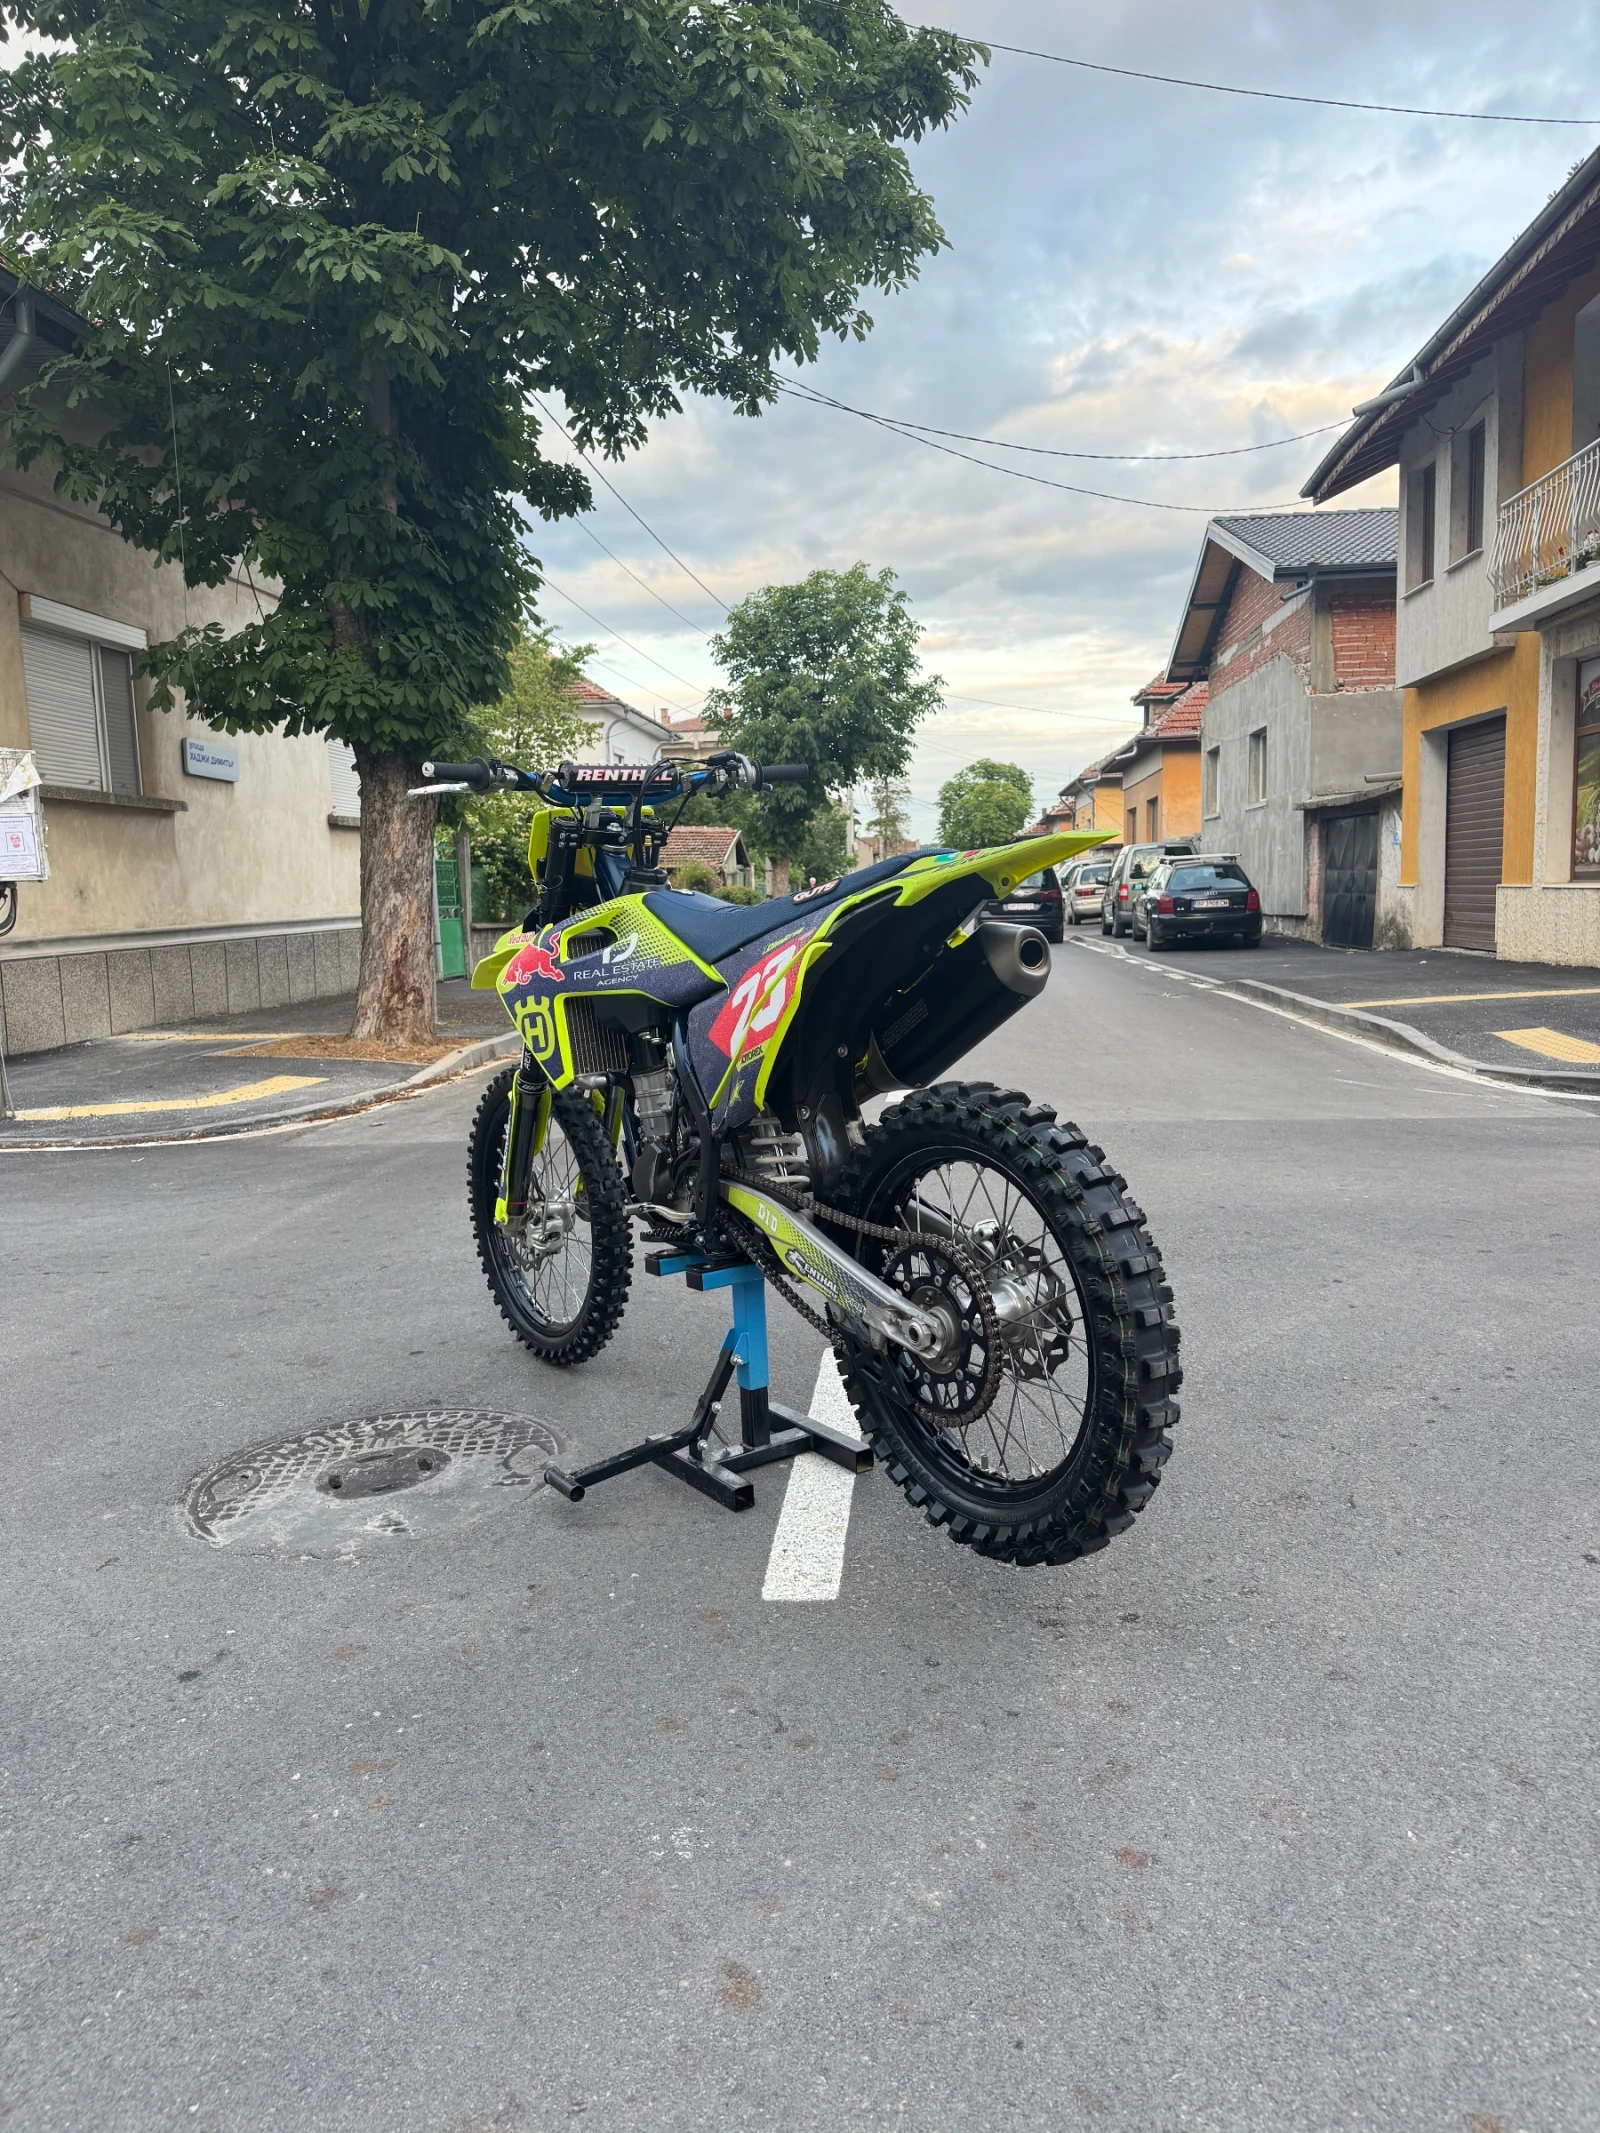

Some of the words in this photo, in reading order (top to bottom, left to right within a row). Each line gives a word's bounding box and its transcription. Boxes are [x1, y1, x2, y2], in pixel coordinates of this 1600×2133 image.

[189, 752, 211, 763] ХАДЖИ
[573, 968, 610, 981] REAL
[612, 957, 661, 975] ESTATE
[596, 973, 639, 987] AGENCY
[741, 1044, 764, 1065] OTOREX
[757, 1202, 778, 1233] DID
